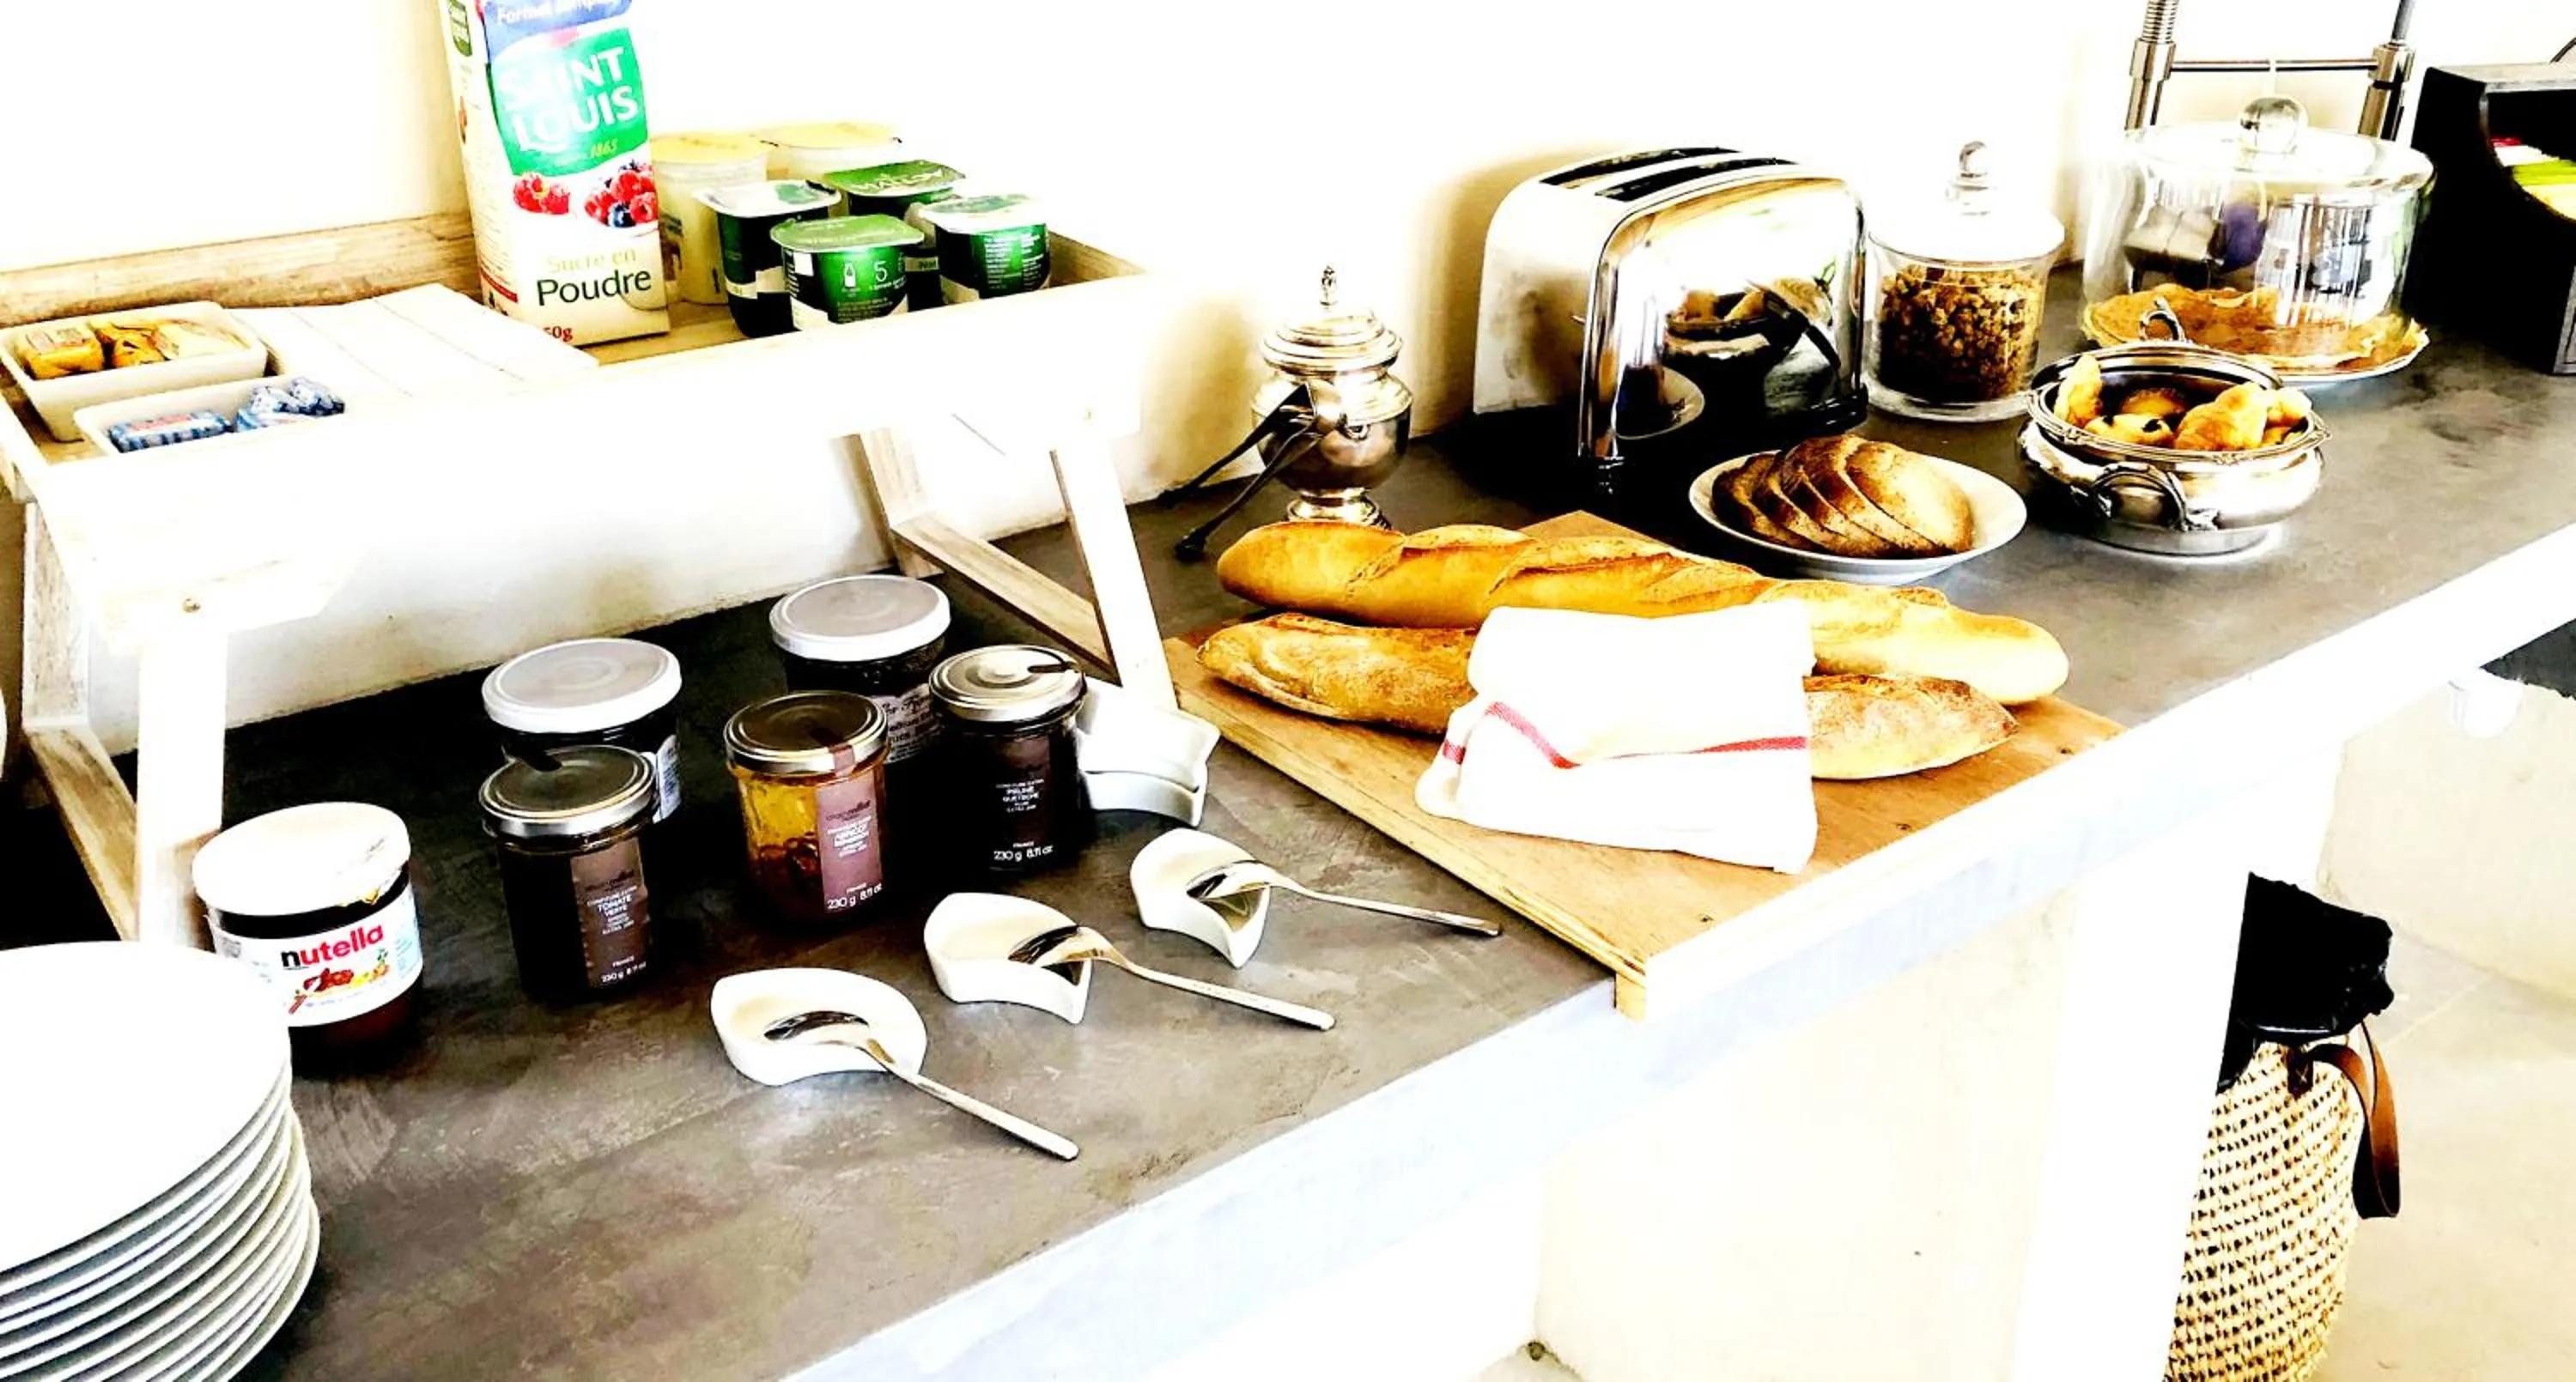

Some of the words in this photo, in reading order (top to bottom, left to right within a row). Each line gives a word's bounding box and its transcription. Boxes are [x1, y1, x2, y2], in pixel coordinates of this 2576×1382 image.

[499, 46, 625, 111] SAINT
[512, 84, 638, 152] LOUIS
[547, 254, 605, 273] Sucre
[611, 247, 636, 266] en
[873, 260, 888, 282] 5
[537, 269, 652, 306] Poudre
[281, 924, 384, 967] nutella
